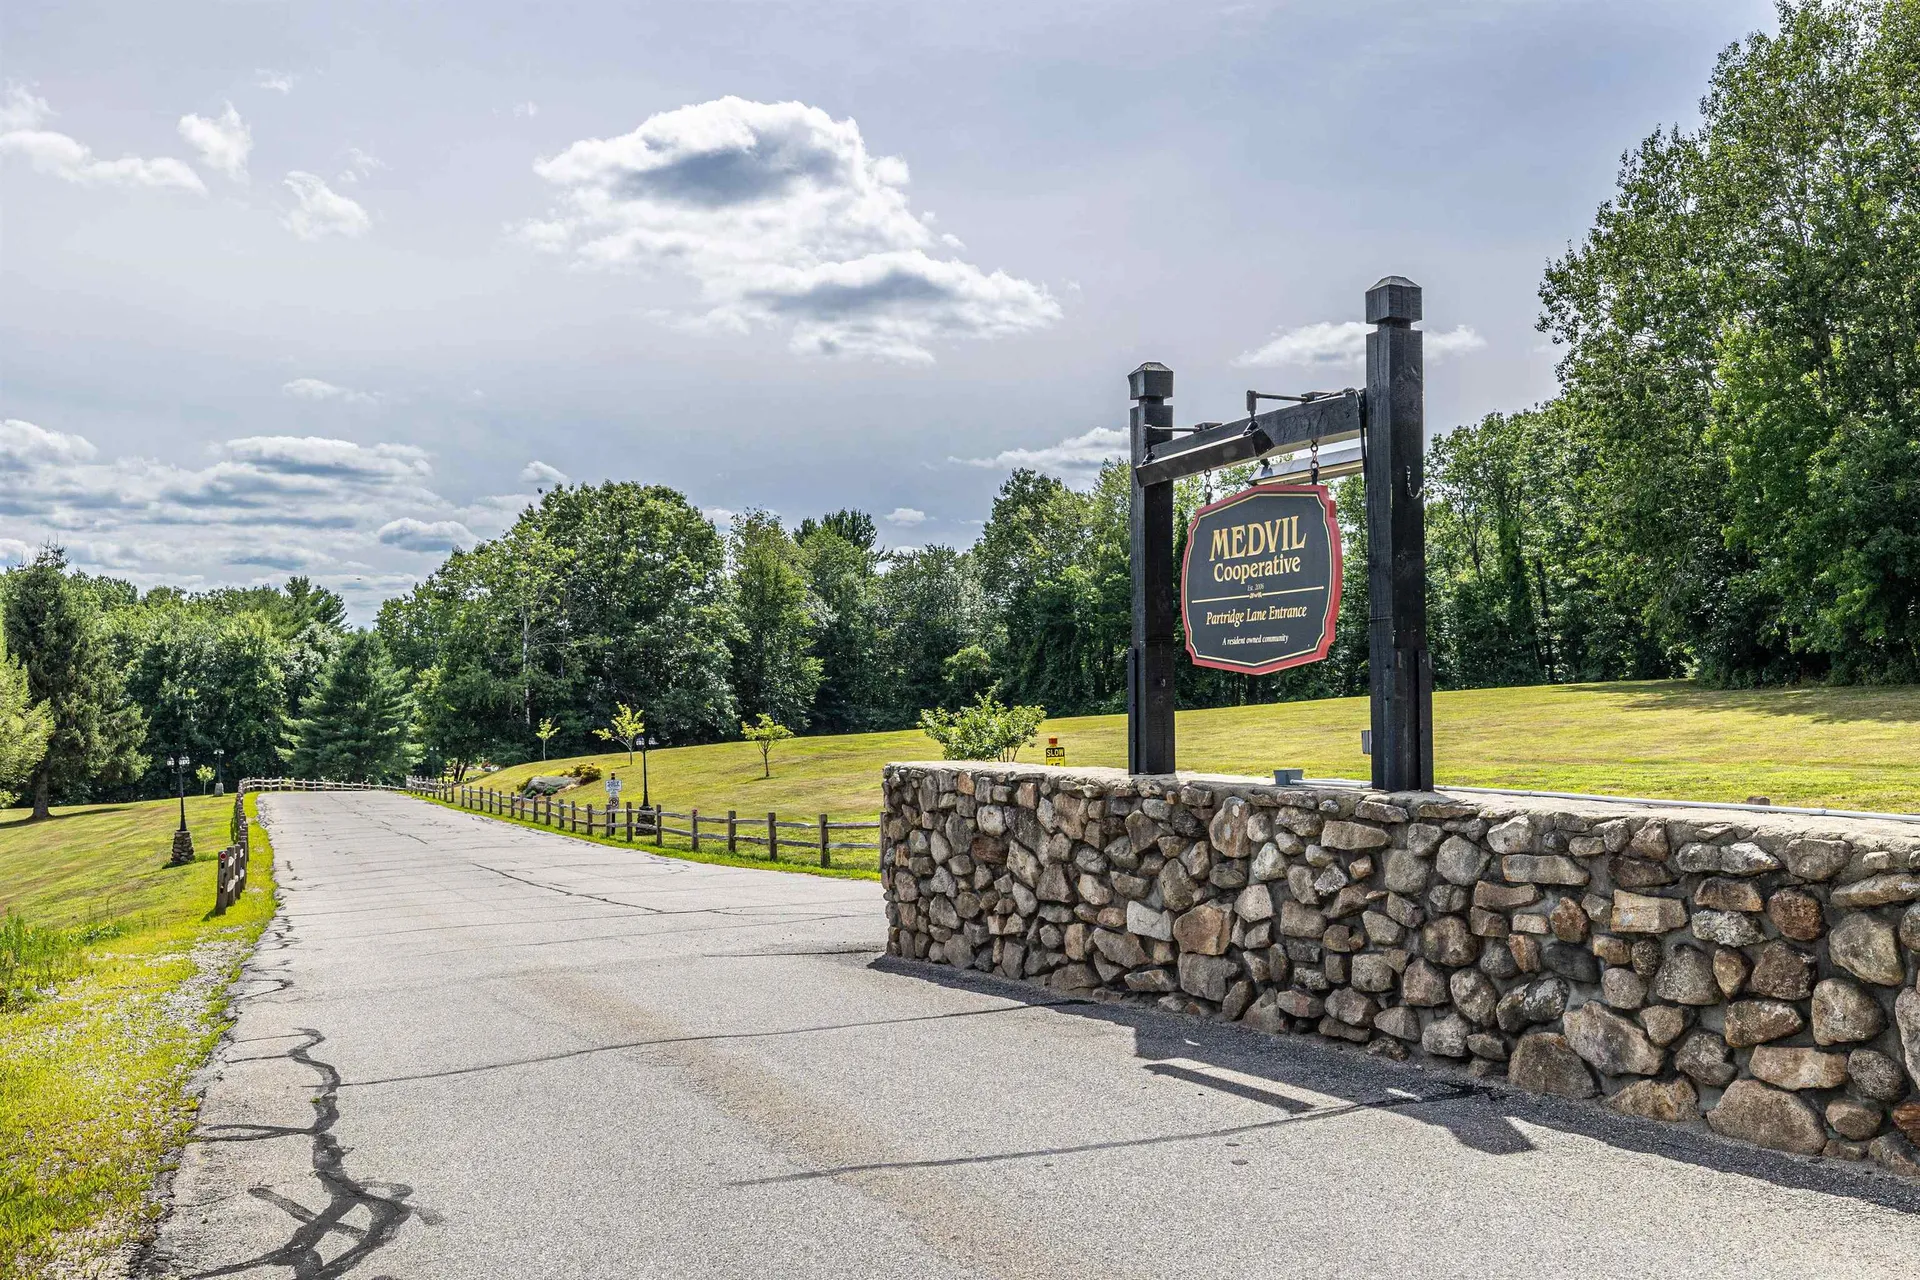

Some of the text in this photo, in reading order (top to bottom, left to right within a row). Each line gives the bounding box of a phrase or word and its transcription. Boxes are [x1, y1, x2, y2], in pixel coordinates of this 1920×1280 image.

[1209, 516, 1307, 561] MEDVIL
[1213, 553, 1301, 584] Cooperative
[1206, 606, 1307, 627] Partridge Lane Entrance
[1222, 633, 1289, 646] A resident owned community
